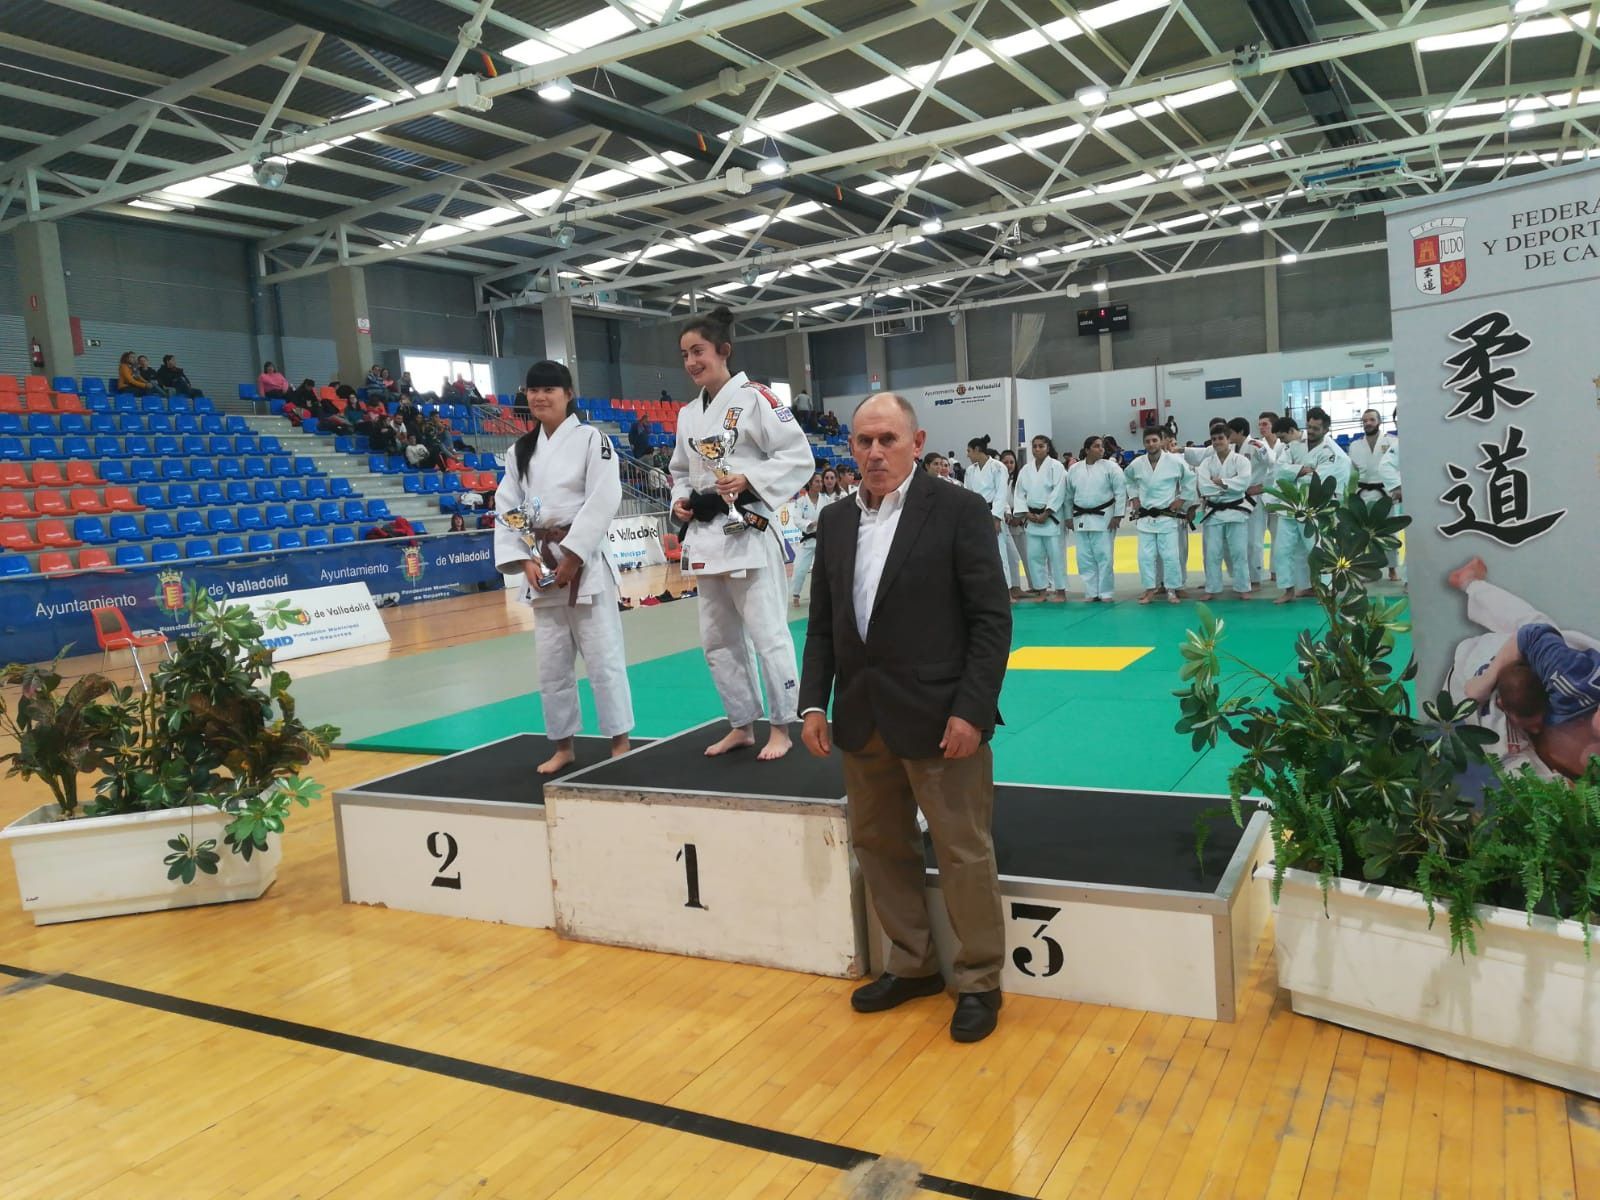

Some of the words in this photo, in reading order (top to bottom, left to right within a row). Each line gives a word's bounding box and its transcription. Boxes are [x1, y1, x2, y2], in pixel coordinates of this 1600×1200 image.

[1440, 236, 1464, 259] JUDO
[1483, 240, 1498, 256] Y
[1505, 220, 1600, 252] DEPORT
[1524, 250, 1556, 270] DE
[1563, 243, 1599, 263] CA
[1438, 311, 1568, 546] 柔道
[320, 563, 389, 583] Ayuntamiento
[435, 555, 447, 567] de
[448, 549, 491, 566] Valladolid
[35, 594, 137, 619] Ayuntamiento
[208, 583, 224, 596] de
[226, 574, 289, 594] Valladolid
[314, 608, 326, 619] de
[327, 603, 371, 617] Valladolid
[425, 831, 461, 890] 2
[675, 843, 707, 908] 1
[1011, 903, 1064, 977] 3
